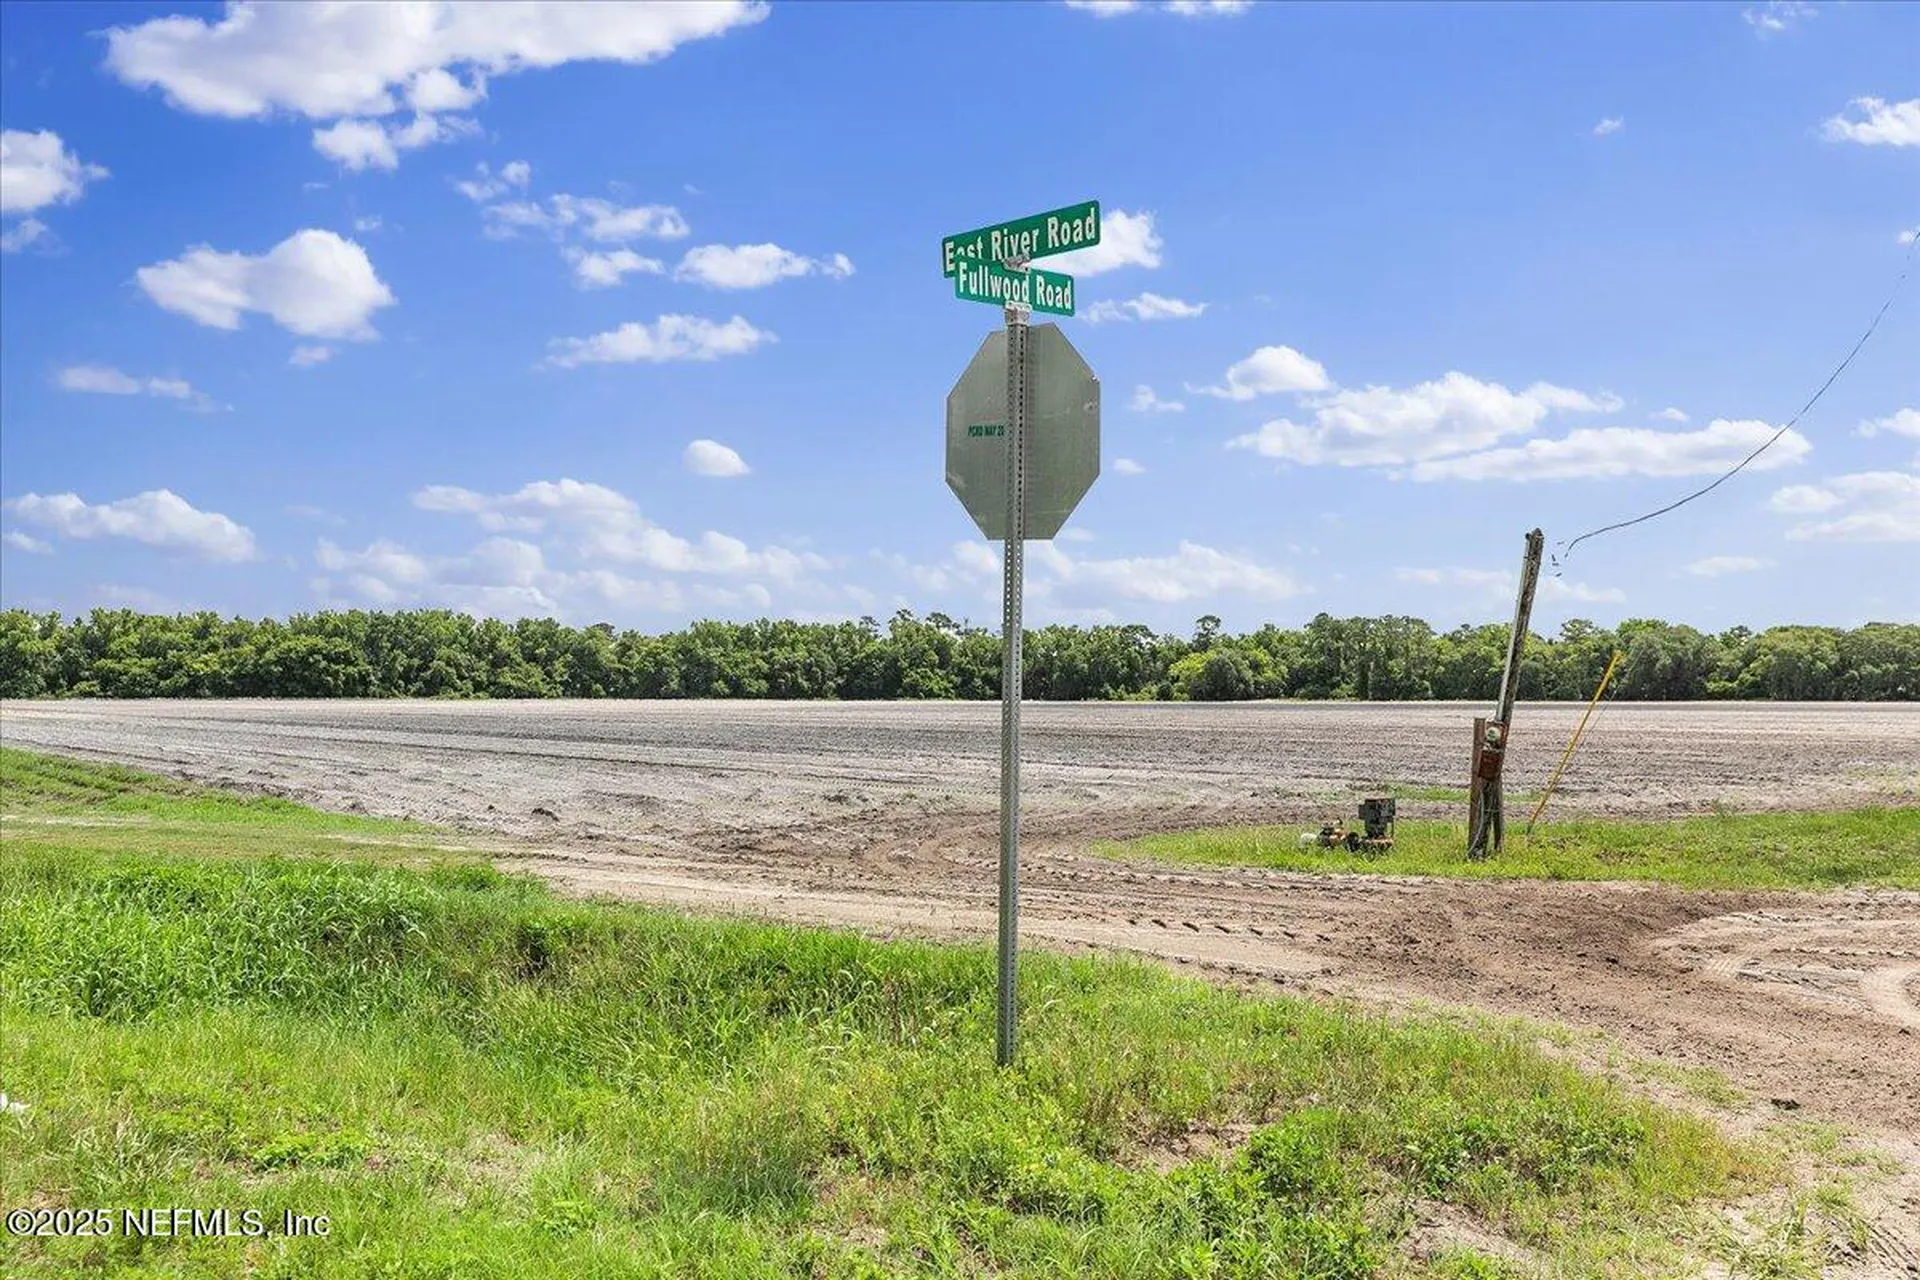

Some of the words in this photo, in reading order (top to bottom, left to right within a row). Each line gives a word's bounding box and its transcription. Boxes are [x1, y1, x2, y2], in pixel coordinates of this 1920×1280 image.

[991, 228, 1040, 261] River
[1047, 207, 1096, 249] Road
[959, 261, 1030, 303] Fullwood
[1036, 275, 1072, 310] Road
